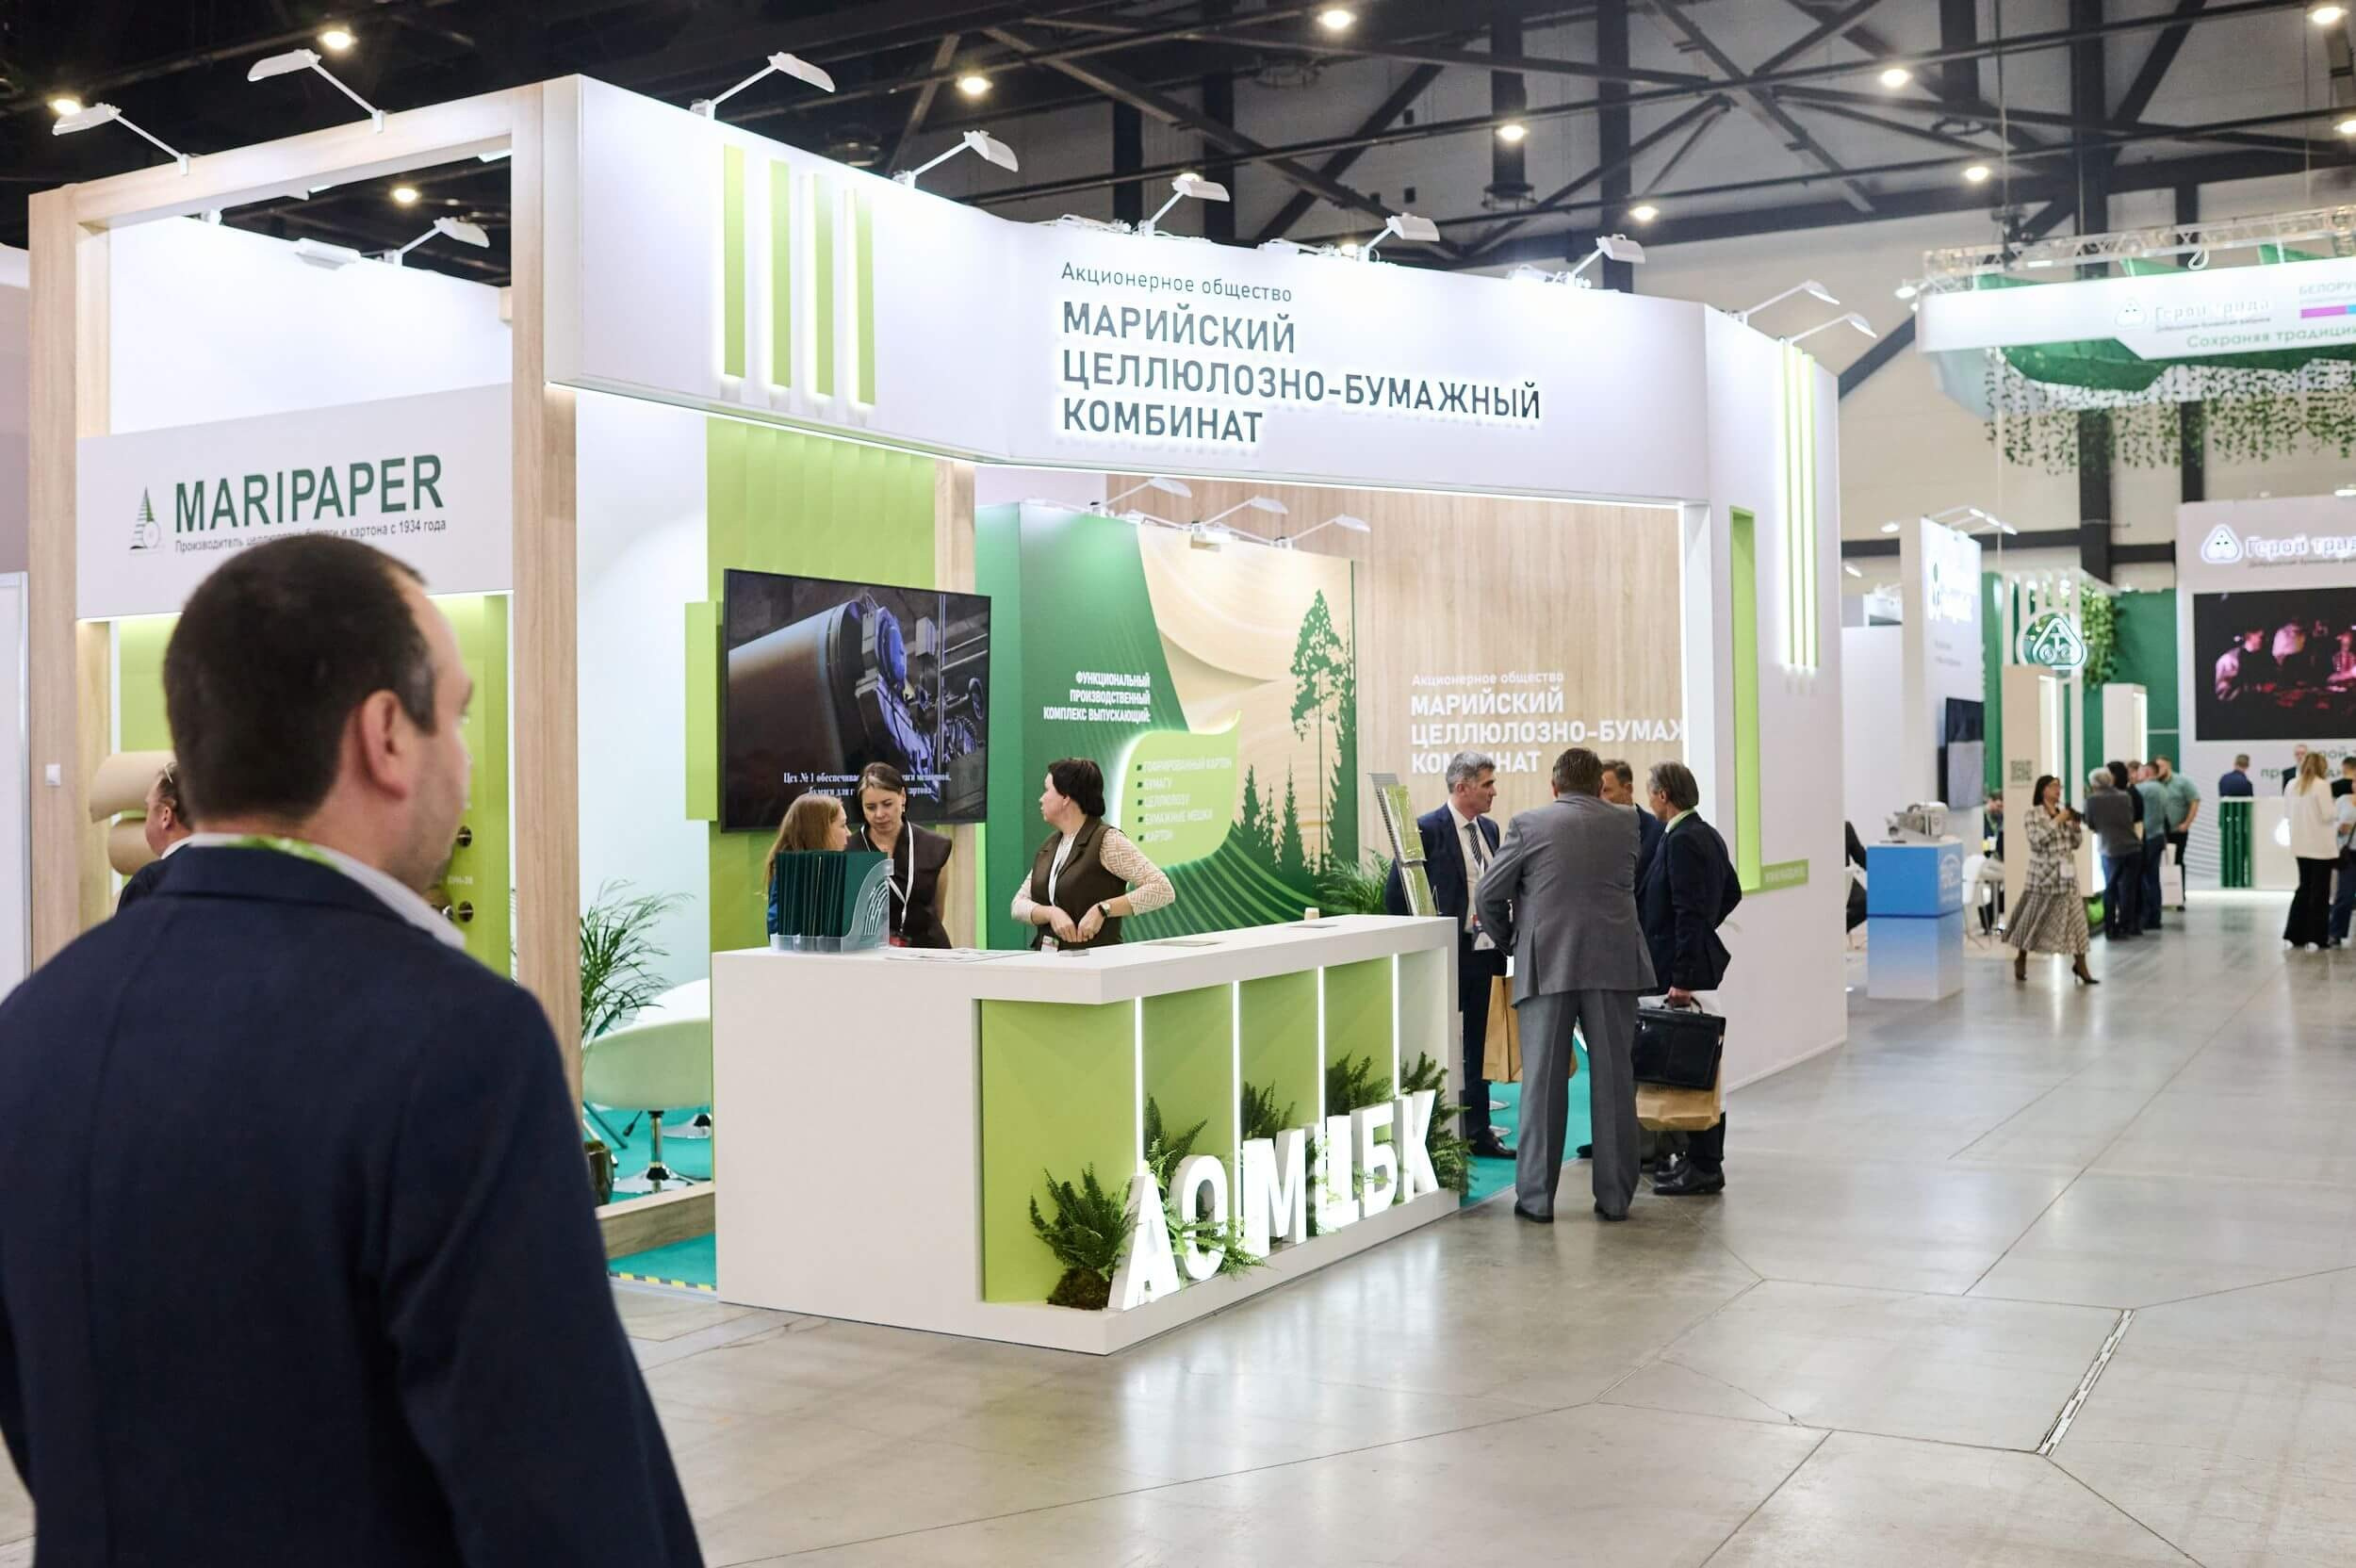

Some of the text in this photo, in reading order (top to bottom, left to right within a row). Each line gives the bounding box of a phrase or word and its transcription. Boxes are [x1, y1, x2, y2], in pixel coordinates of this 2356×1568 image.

[1061, 262, 1292, 302] Акционерное общество
[1064, 301, 1294, 353] МАРИЙСКИЙ
[2186, 331, 2270, 348] Сохраняя
[1064, 350, 1539, 419] ЦЕЛЛЮЛОЗНО-БУМАЖНЫЙ
[1064, 398, 1263, 442] КОМБИНАТ
[175, 453, 443, 533] MARIPAPER
[351, 524, 387, 538] картона
[390, 524, 396, 534] с
[399, 520, 421, 533] 1934
[423, 519, 447, 532] года
[1075, 671, 1151, 687] ФУНКЦИОНАЛЬНЫЙ
[1412, 671, 1564, 687] Акционерное общество
[1070, 689, 1151, 705] ПРОИЗВОДСТВЕННЫЙ
[1411, 686, 1564, 716] МАРИЙСКИЙ
[1043, 706, 1088, 721] КОМПЛЕКС
[1412, 750, 1542, 775] КОНАТ
